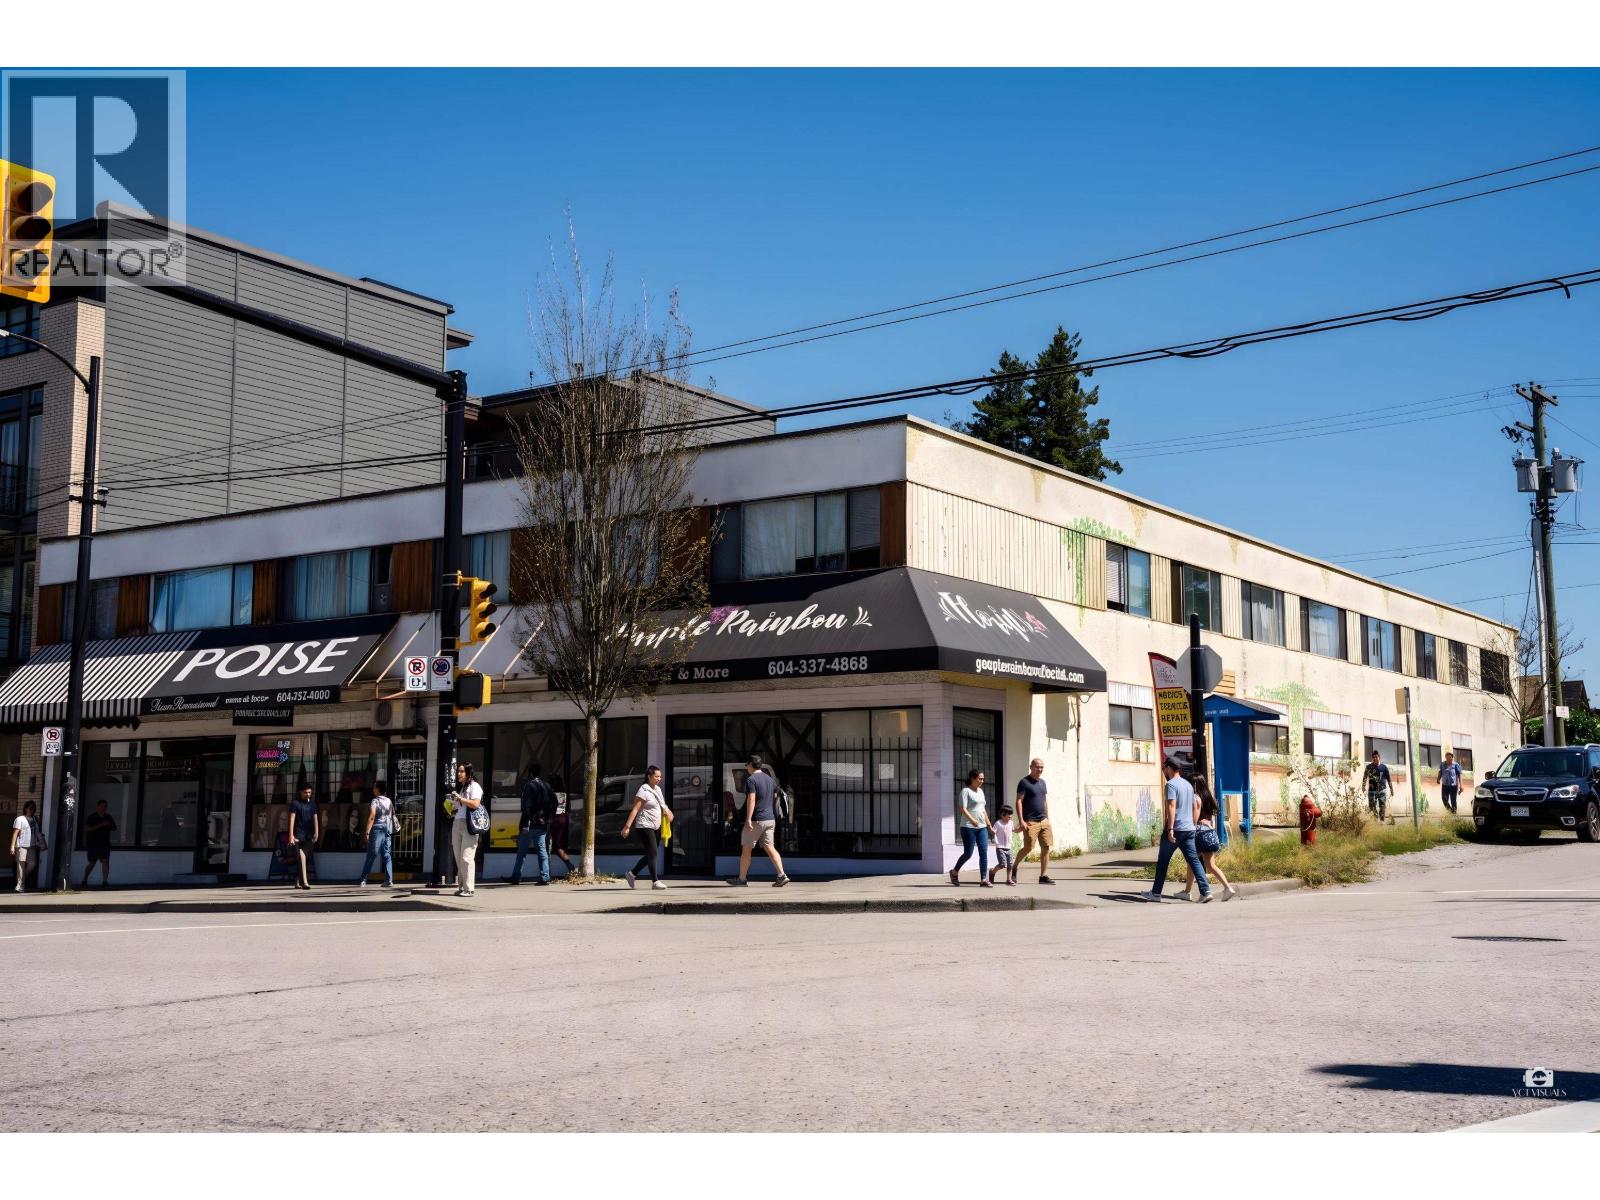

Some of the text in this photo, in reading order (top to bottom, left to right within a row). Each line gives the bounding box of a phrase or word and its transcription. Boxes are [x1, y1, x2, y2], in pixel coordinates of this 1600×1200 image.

[172, 636, 361, 682] POISE
[768, 656, 869, 675] 604-337-4868
[678, 668, 689, 680] &
[693, 667, 729, 679] More
